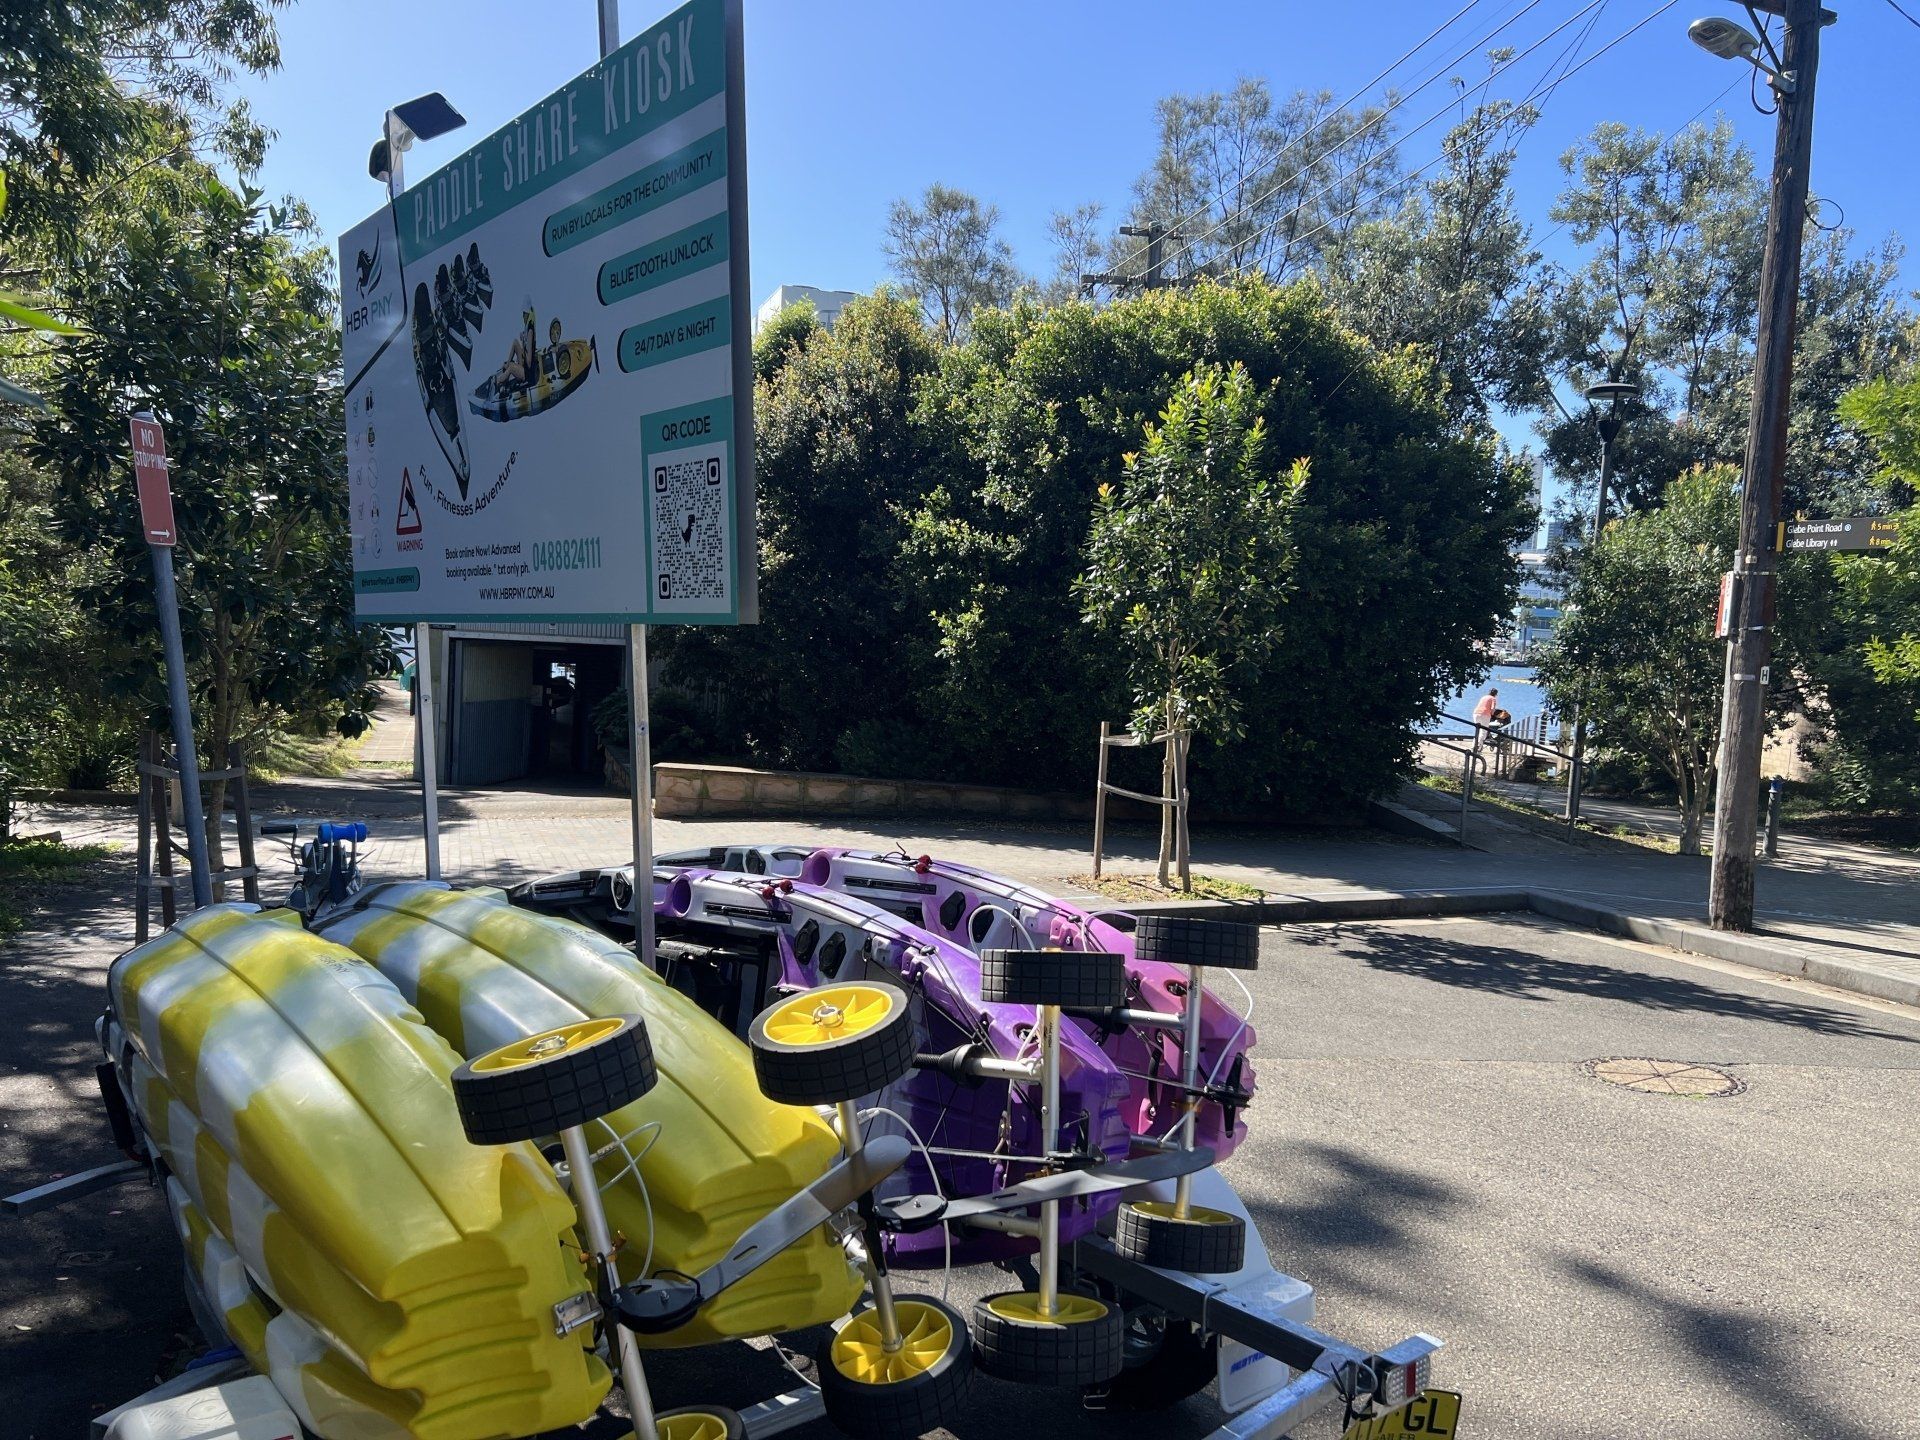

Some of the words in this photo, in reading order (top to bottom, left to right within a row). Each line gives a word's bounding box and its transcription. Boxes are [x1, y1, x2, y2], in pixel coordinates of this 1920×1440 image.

[414, 152, 484, 244] PADDLE
[502, 90, 579, 192] SHARE
[603, 13, 695, 136] KIOSK
[551, 225, 569, 242] RUN
[569, 216, 580, 234] BY
[580, 200, 613, 229] LOCALS
[614, 191, 633, 213] FOR
[633, 182, 651, 203] THE
[652, 150, 713, 194] COMMUNITY
[610, 250, 668, 289] BLUETOOTH
[670, 233, 714, 266] UNLOCK
[346, 306, 369, 335] HBR
[370, 292, 393, 322] PNY
[634, 335, 655, 356] 24/7
[656, 328, 676, 349] DAY
[677, 326, 684, 343] &
[686, 316, 716, 339] NIGHT
[140, 428, 155, 448] NO
[661, 422, 677, 442] QR
[679, 415, 711, 439] CODE
[136, 450, 168, 470] STOPPING
[436, 489, 474, 517] Fitnesses
[1787, 525, 1806, 534] Glebe
[1806, 524, 1824, 533] Point
[1825, 522, 1843, 532] Road
[1882, 522, 1893, 531] min
[397, 539, 424, 552] WARNING
[445, 547, 458, 560] Book
[459, 546, 475, 558] online
[491, 541, 521, 555] Advanced
[1785, 539, 1805, 549] Glebe
[1805, 538, 1829, 550] Library
[532, 537, 601, 572] 0488824111
[446, 566, 467, 581] booking
[507, 562, 519, 577] only
[479, 586, 555, 600] WWW.HBRPNY.COM.AU
[1761, 669, 1769, 679] H
